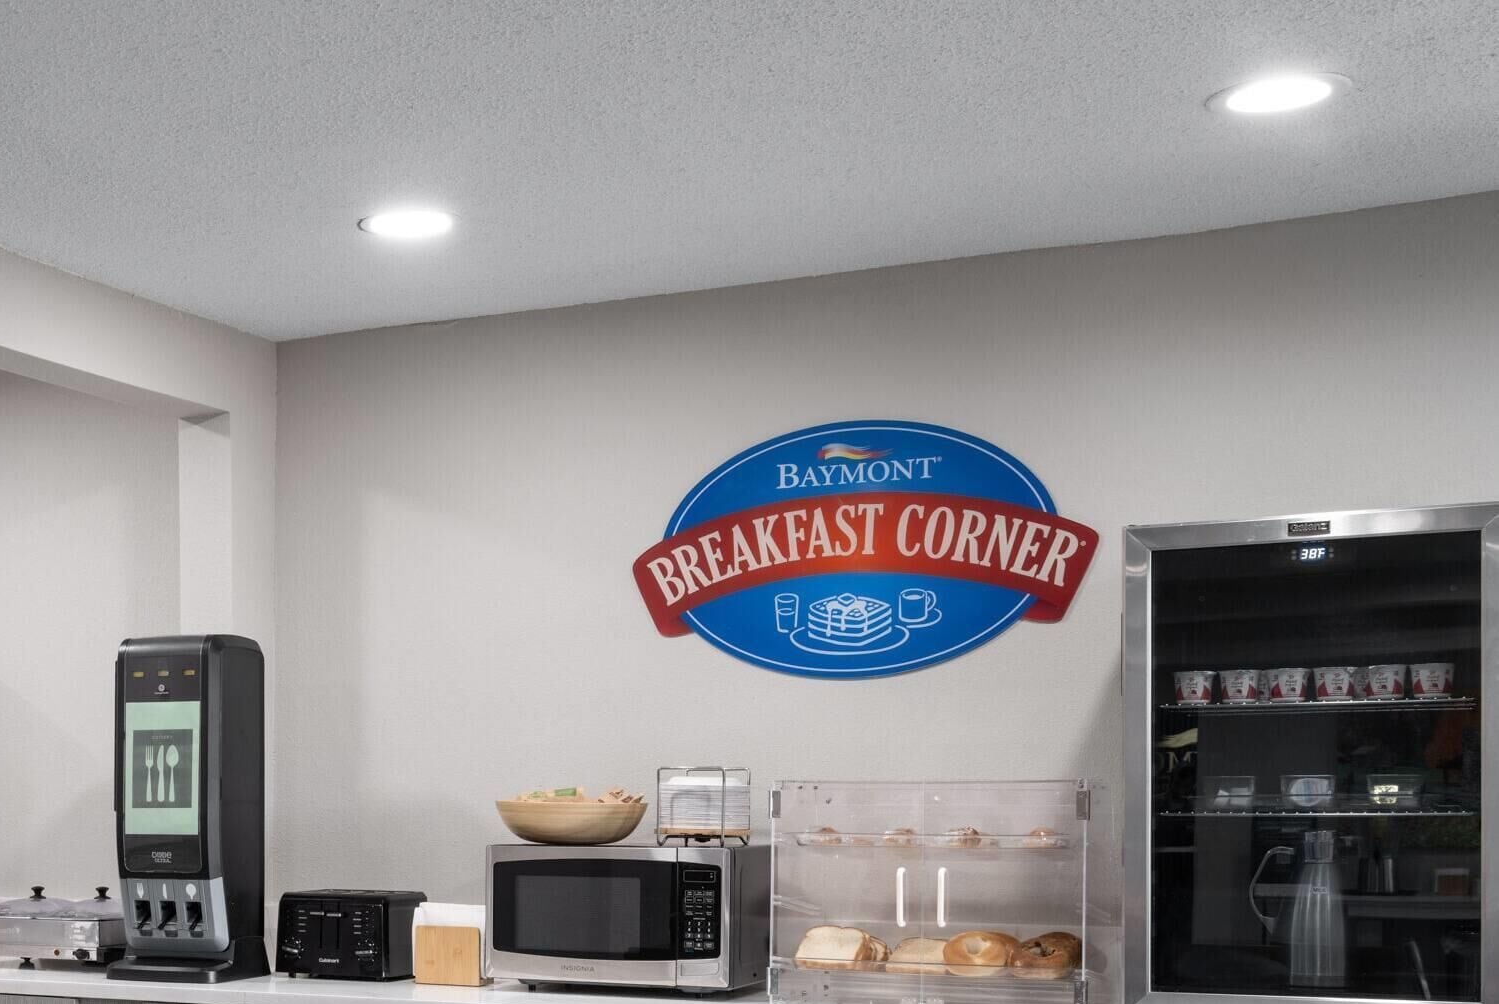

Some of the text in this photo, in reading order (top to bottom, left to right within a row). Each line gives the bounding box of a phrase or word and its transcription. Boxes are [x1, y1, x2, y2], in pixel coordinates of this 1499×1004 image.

[776, 455, 938, 489] BAYMONT
[646, 503, 1079, 607] BREAKFAST CORNER
[1301, 547, 1326, 560] 38F
[560, 964, 595, 972] INSIGNIA
